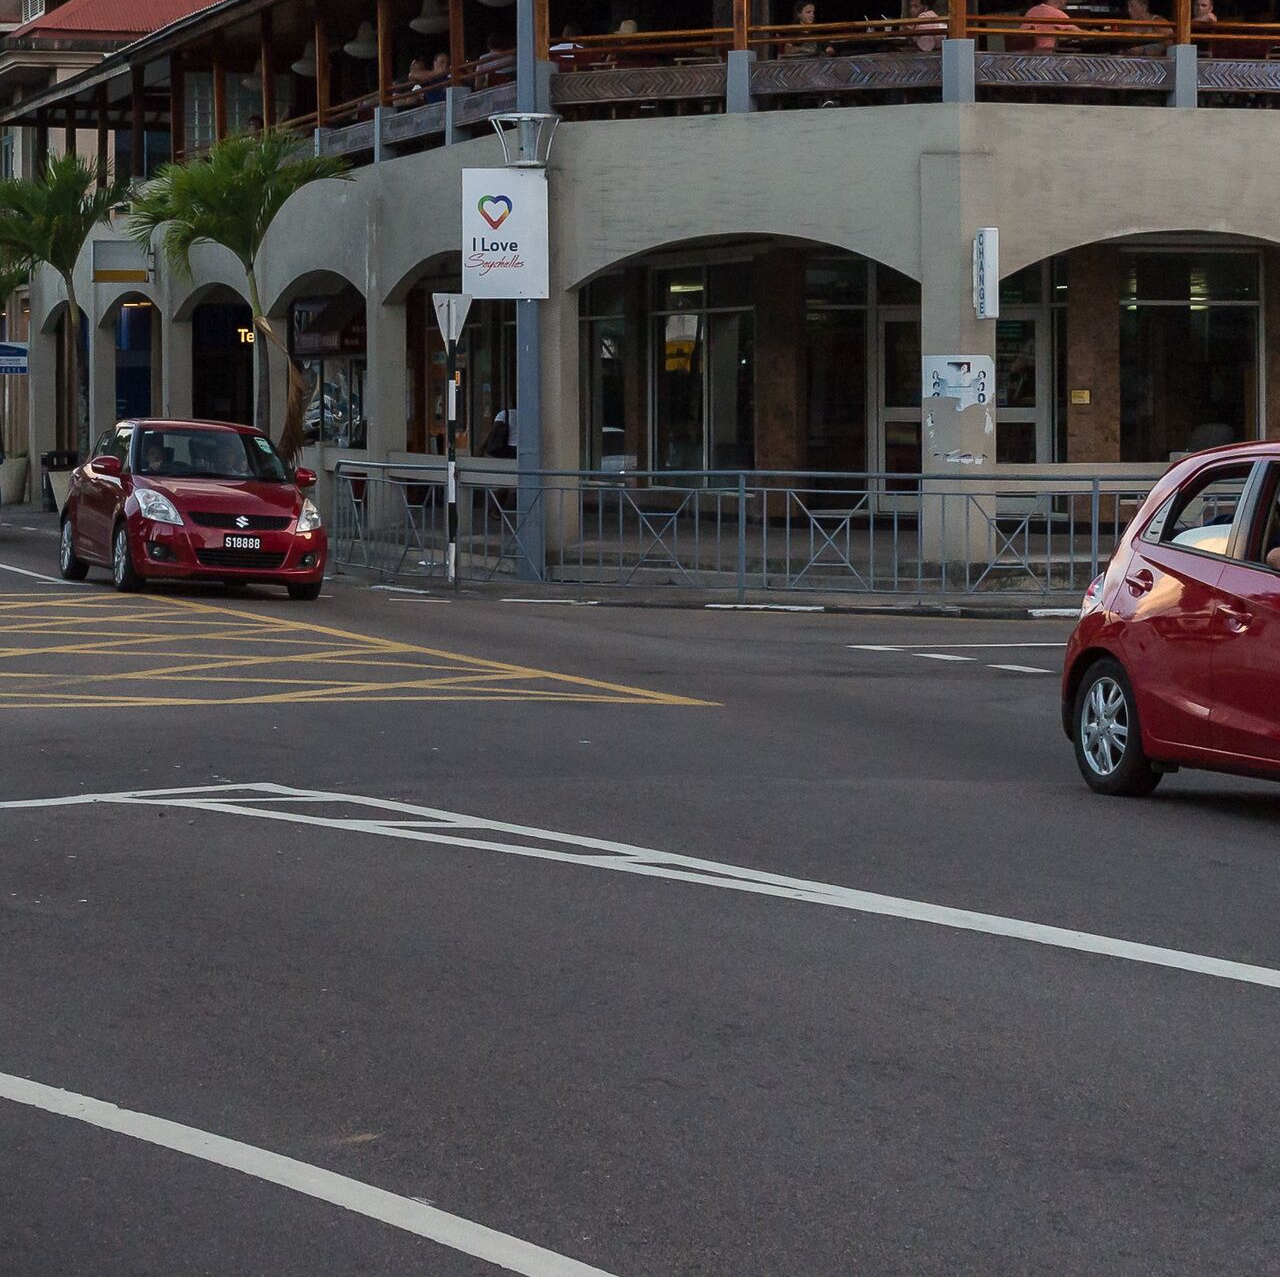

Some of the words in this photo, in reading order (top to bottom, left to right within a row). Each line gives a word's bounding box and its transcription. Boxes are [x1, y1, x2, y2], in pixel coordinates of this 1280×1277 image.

[481, 237, 518, 252] Love
[464, 253, 525, 276] Seychelles
[977, 233, 986, 315] CHANGE
[225, 536, 261, 549] S18888
